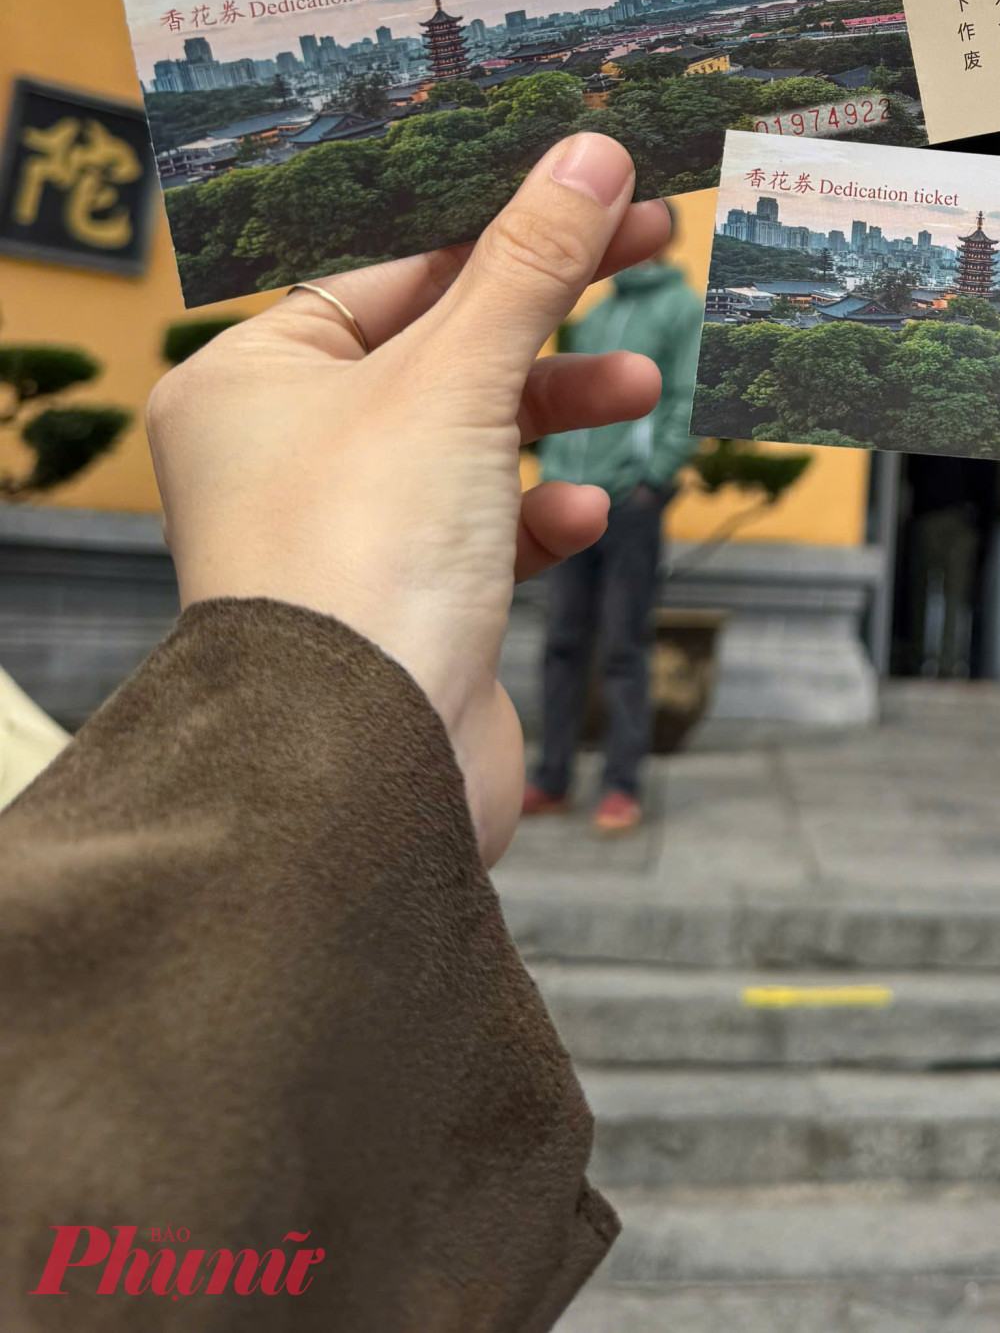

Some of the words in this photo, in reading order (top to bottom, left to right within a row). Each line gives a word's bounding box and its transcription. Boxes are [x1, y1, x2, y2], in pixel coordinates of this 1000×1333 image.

[160, 0, 245, 32] 香花券
[744, 168, 815, 194] 香花券
[819, 179, 908, 202] Dedication
[914, 188, 959, 207] ticket
